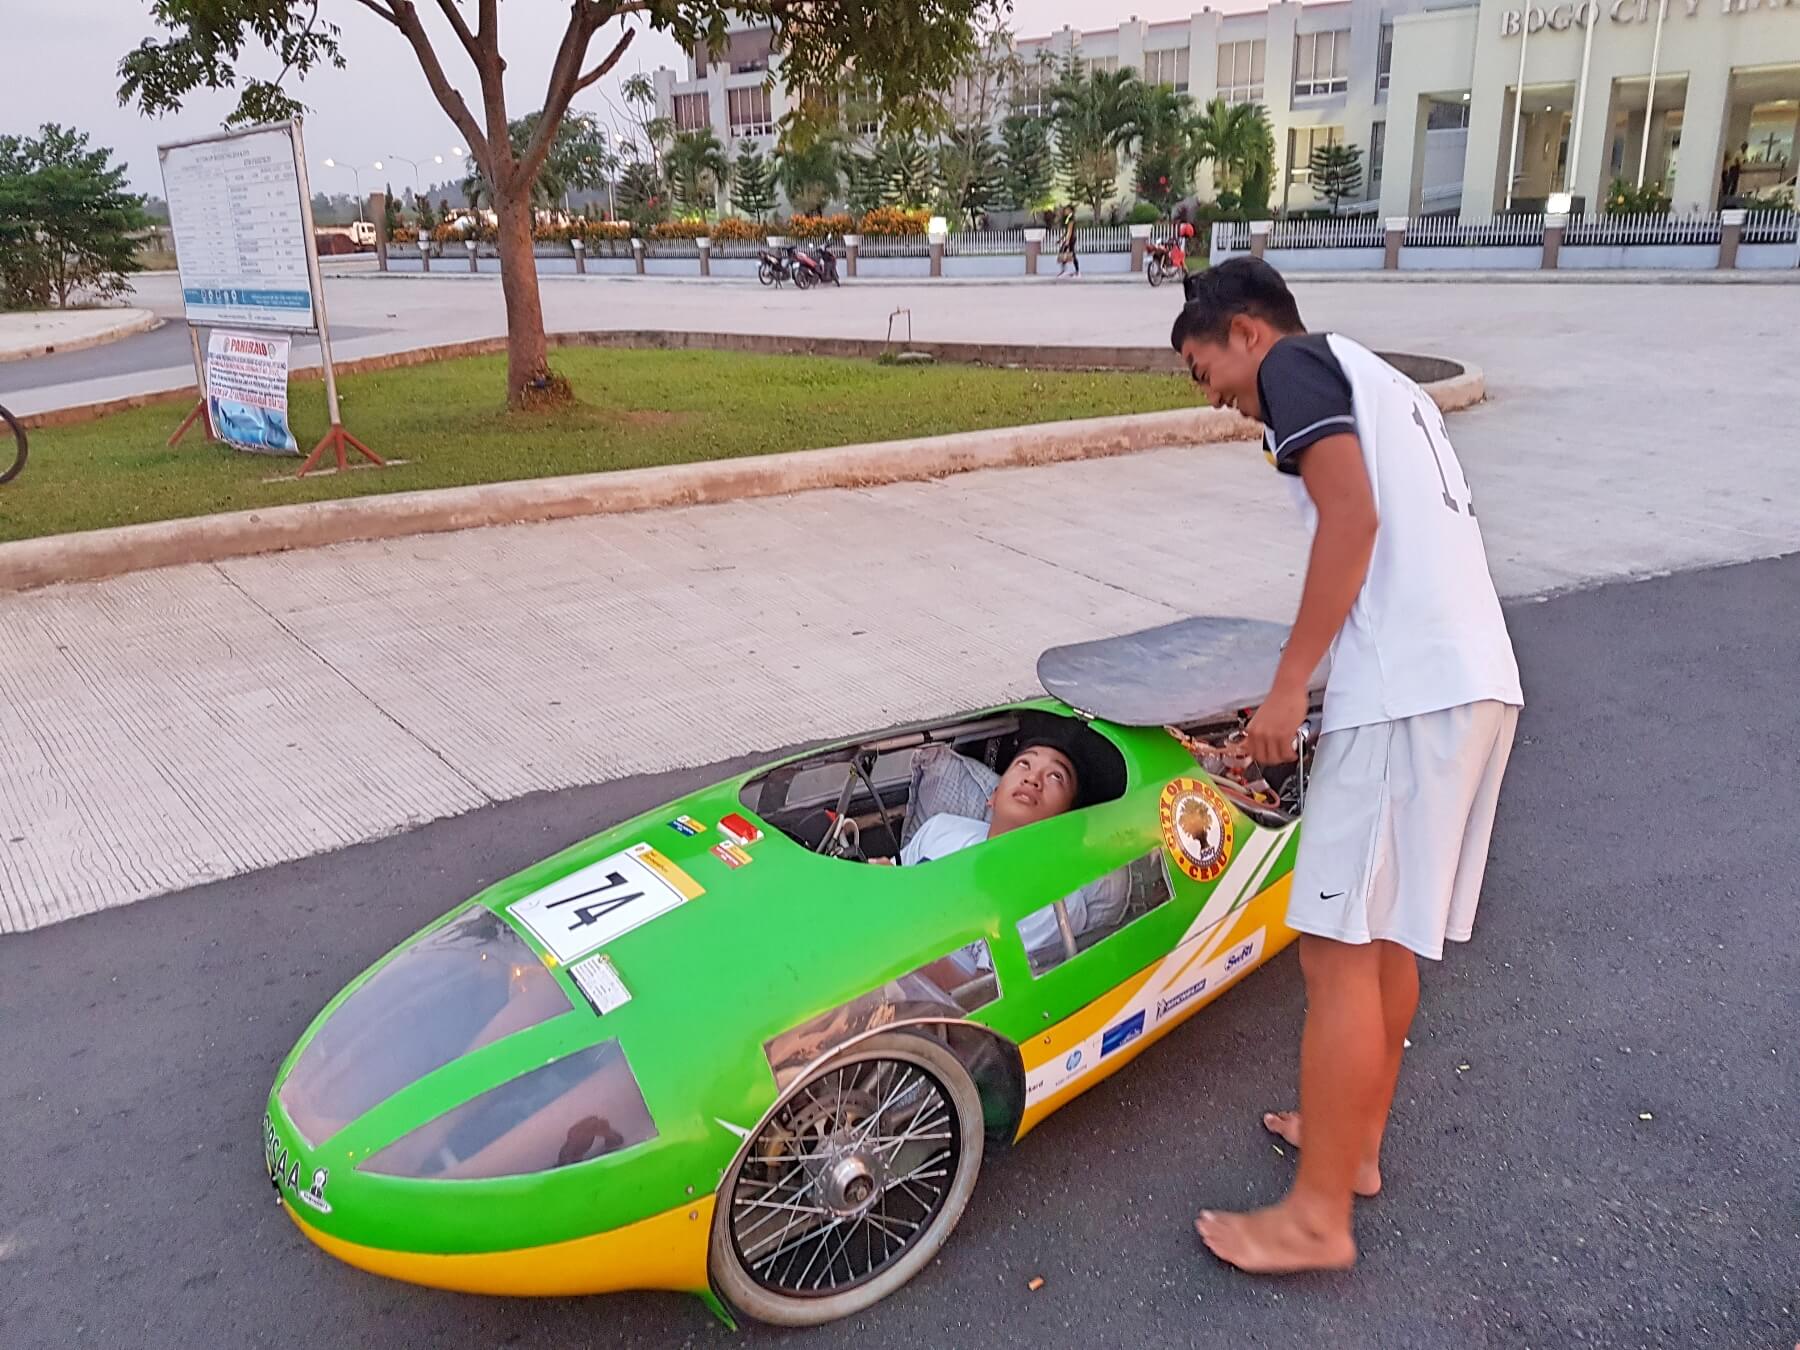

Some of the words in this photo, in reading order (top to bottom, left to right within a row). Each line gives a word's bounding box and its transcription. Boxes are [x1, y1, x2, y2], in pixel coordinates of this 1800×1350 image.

[1501, 1, 1600, 37] BOGO
[1188, 852, 1228, 880] CEBU
[546, 871, 646, 931] 74
